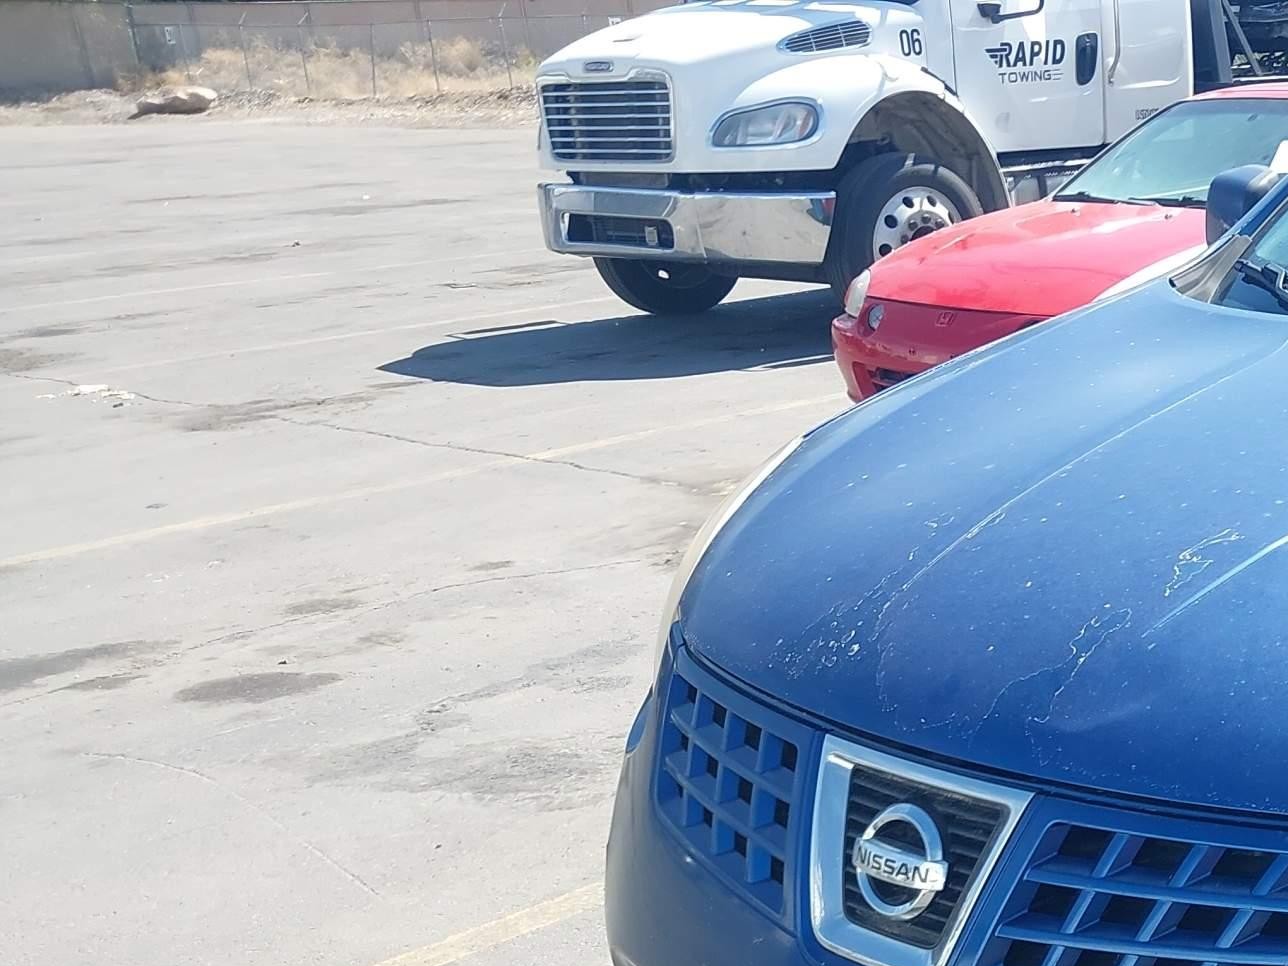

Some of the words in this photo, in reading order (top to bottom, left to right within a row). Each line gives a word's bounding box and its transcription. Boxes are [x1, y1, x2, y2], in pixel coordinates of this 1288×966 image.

[899, 28, 923, 58] 06
[985, 39, 1066, 69] RAPID
[999, 69, 1053, 85] TOWING
[856, 846, 929, 883] NISSAN
